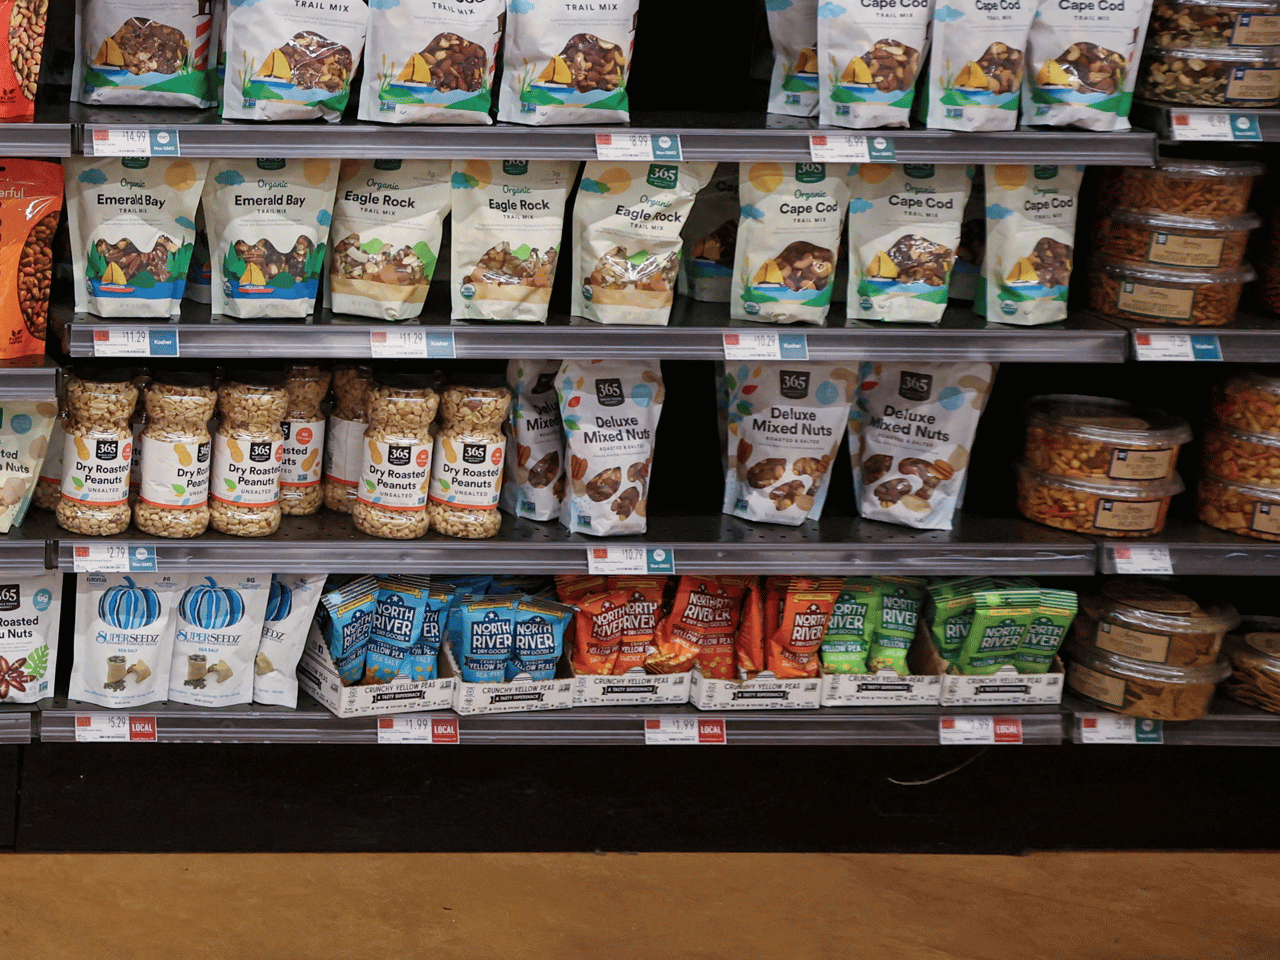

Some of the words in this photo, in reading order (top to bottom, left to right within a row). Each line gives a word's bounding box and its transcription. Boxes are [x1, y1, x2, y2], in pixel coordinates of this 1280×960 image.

[123, 130, 146, 142] $14.99
[97, 194, 143, 205] Emerald
[145, 194, 166, 209] Bay
[489, 199, 517, 212] Eagle
[520, 200, 549, 210] Rock
[596, 416, 638, 428] Deluxe
[584, 430, 623, 443] Mixed
[626, 429, 650, 440] Nuts
[98, 444, 116, 456] 365
[76, 462, 93, 474] Dry
[96, 465, 128, 473] Roasted
[85, 475, 122, 484] Peanuts
[8, 629, 32, 638] Nuts
[472, 622, 511, 635] NORTH
[472, 634, 512, 649] RIVER
[482, 686, 513, 694] CRUNCHY
[132, 723, 153, 732] LOCAL
[405, 719, 427, 729] $1.99
